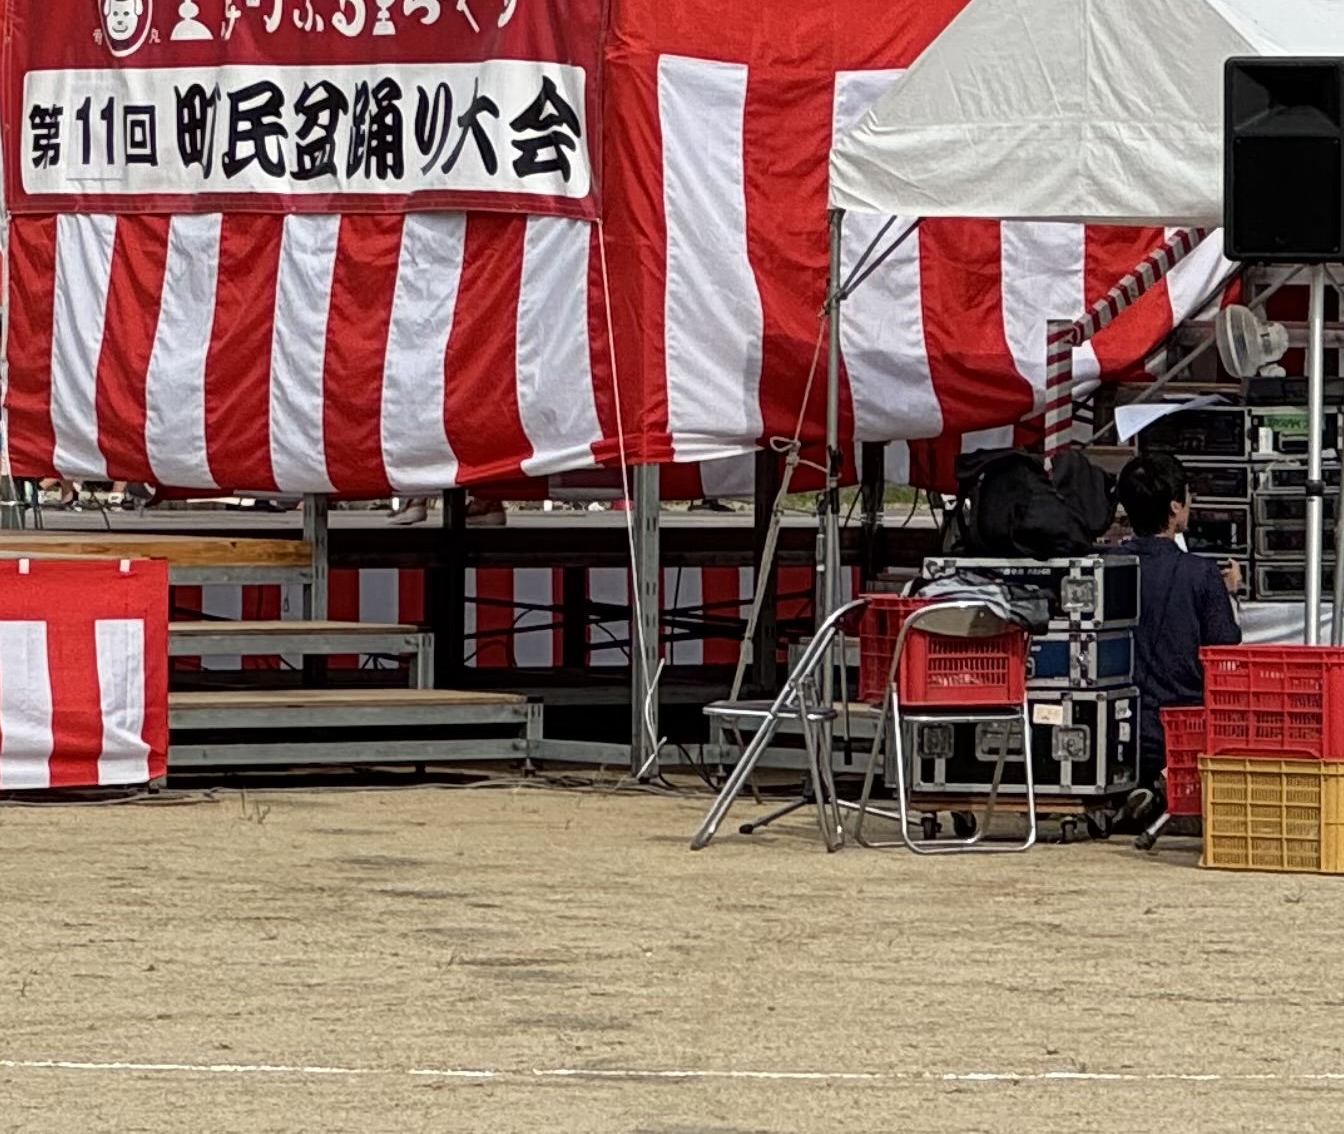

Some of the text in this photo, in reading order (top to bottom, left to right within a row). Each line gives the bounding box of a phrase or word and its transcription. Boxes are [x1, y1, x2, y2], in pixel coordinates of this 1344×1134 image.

[29, 75, 582, 183] 第11回 町民盆踊り大会
